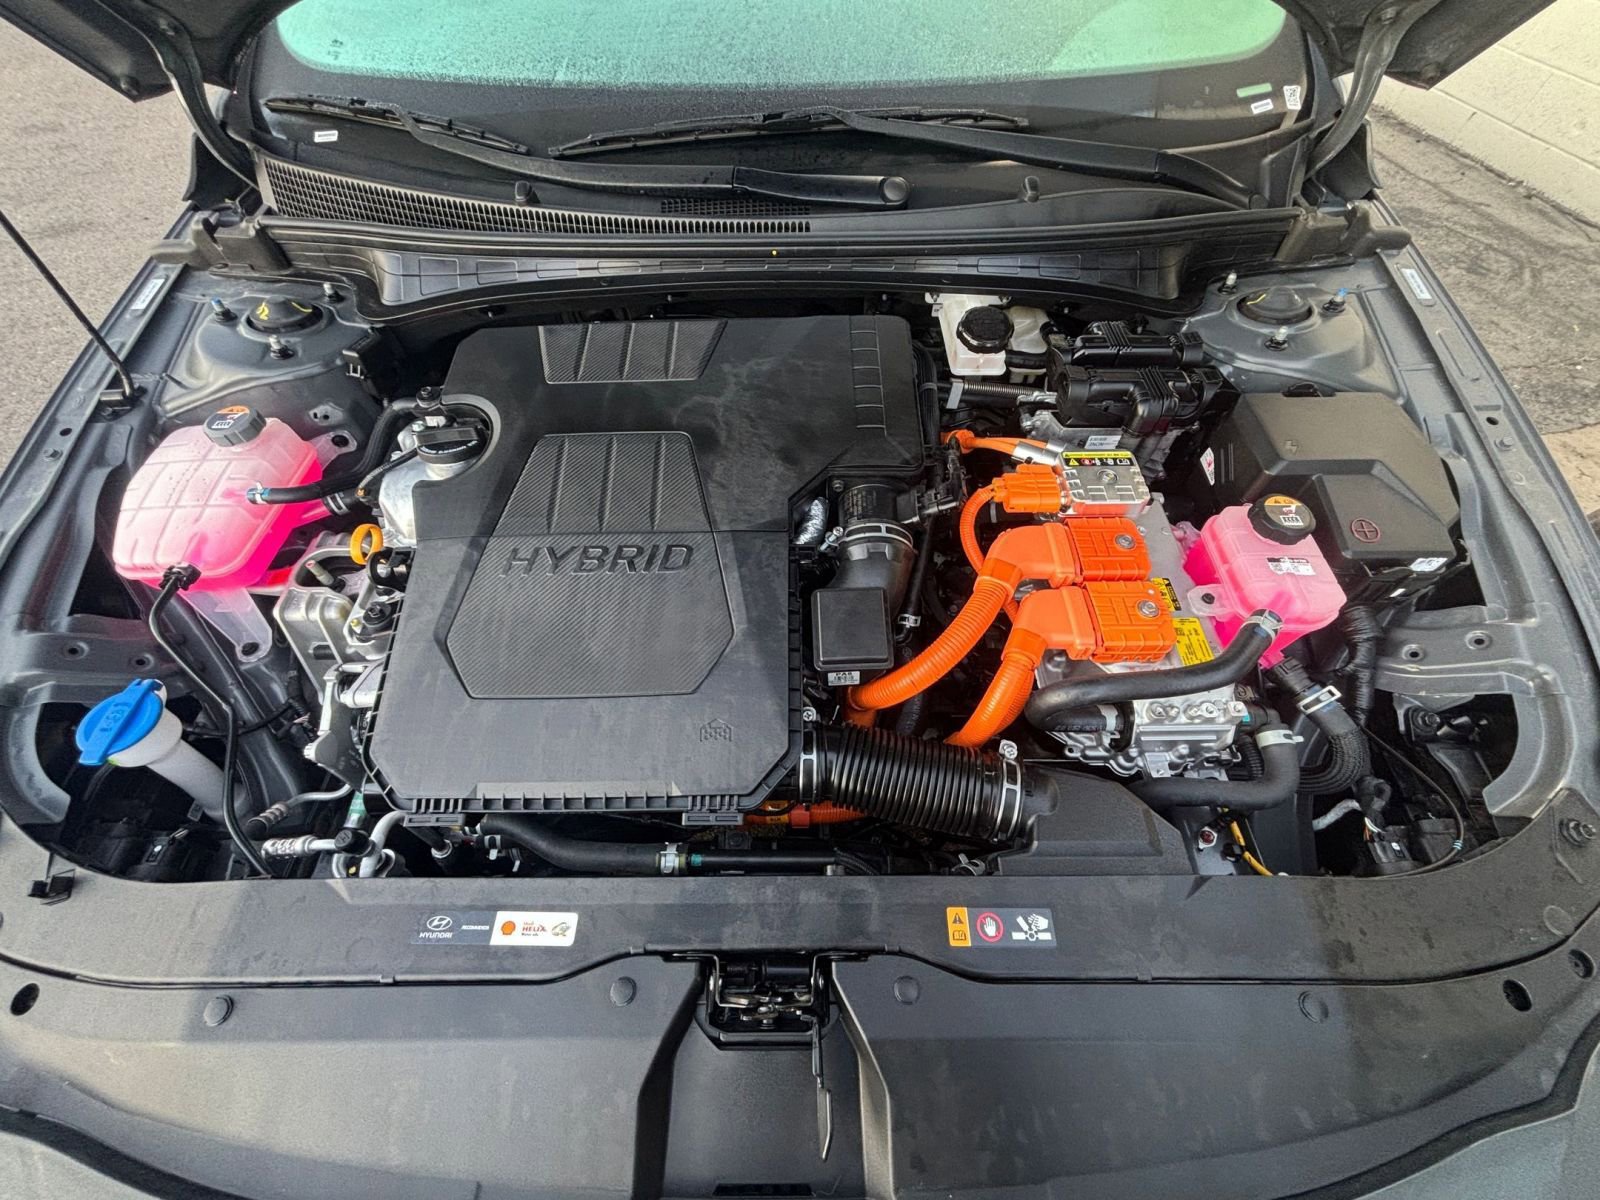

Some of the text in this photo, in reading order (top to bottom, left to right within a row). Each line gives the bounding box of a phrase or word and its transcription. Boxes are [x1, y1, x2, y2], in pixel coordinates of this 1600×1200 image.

[499, 544, 694, 577] HYBRID
[521, 924, 547, 932] HELIX
[419, 931, 453, 939] HYUNDAI
